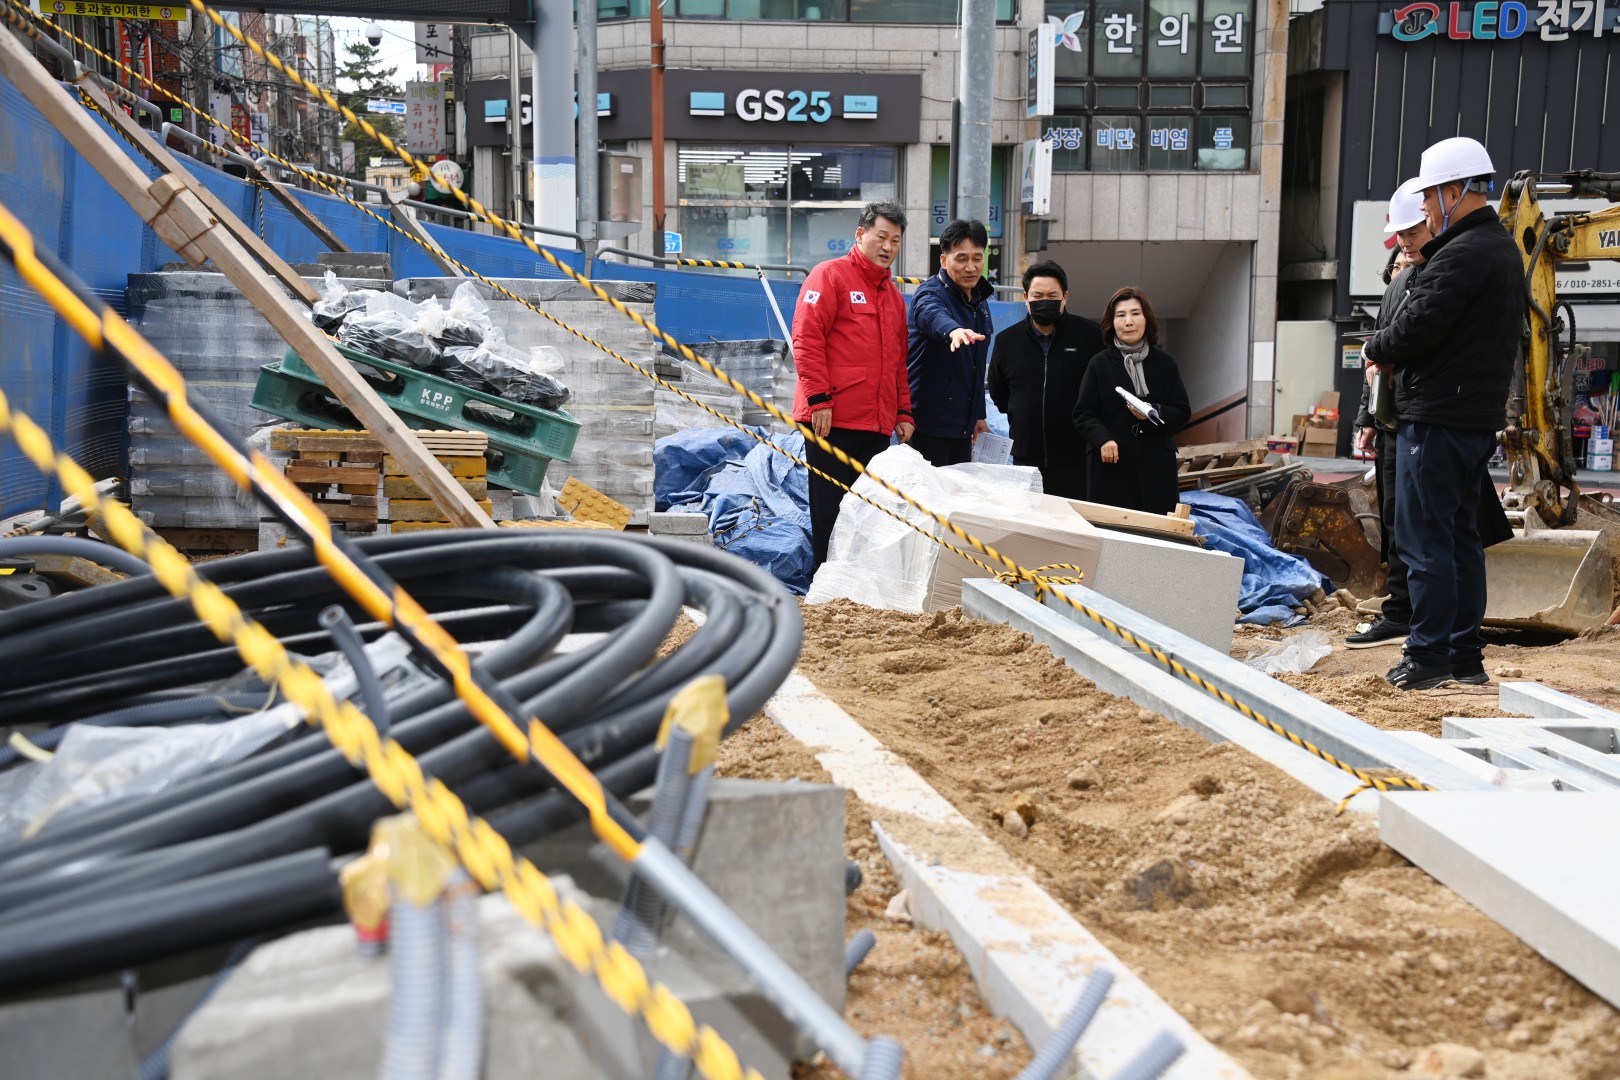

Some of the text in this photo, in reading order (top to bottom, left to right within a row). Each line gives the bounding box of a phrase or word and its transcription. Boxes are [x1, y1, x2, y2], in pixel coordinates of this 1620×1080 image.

[74, 2, 151, 18] 통과높이제한
[1448, 1, 1528, 40] LED
[1535, 0, 1605, 42] 전기
[1103, 12, 1244, 54] 한의원
[735, 88, 832, 123] GS25
[1043, 127, 1234, 150] 성장 비만 비염 뜸
[827, 239, 857, 251] GS2
[1577, 358, 1606, 371] LED
[421, 388, 453, 406] KPP
